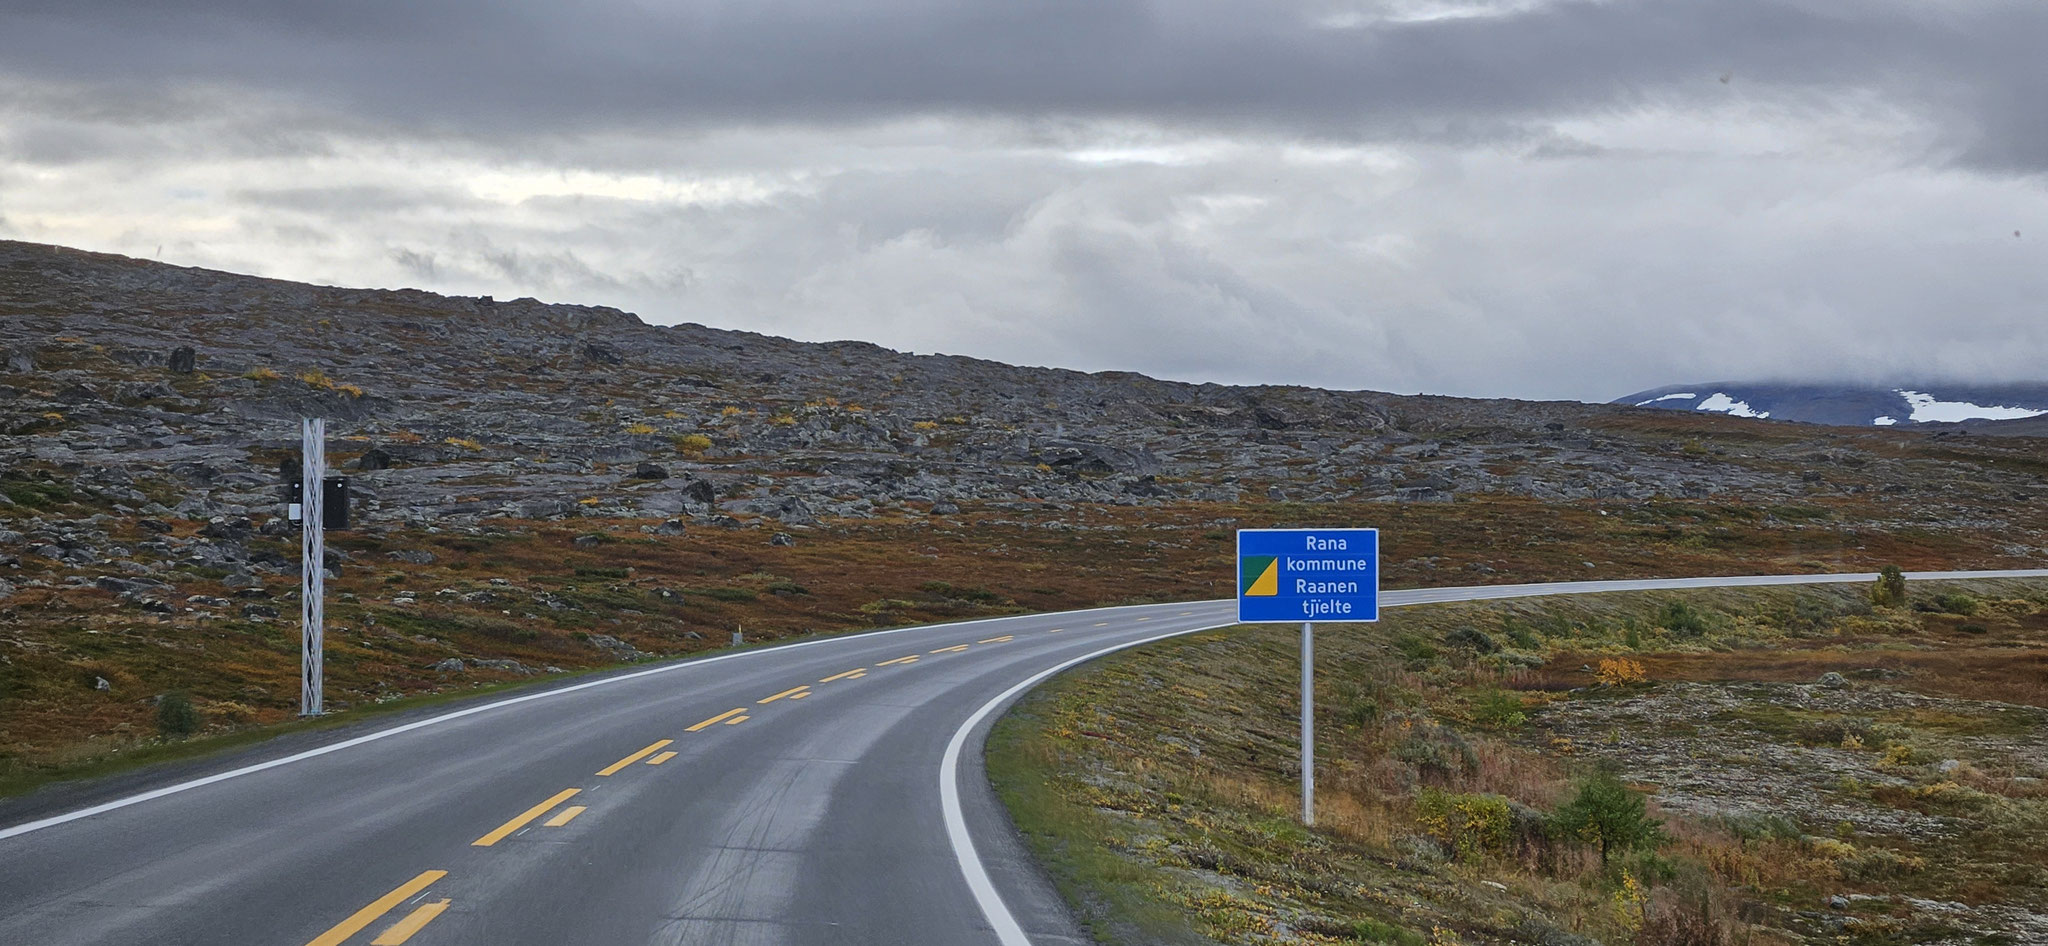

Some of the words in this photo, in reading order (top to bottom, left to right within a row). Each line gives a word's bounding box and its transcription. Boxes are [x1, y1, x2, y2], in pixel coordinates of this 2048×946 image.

[1306, 535, 1347, 551] Rana
[1287, 556, 1367, 571] kommune
[1296, 579, 1358, 594] Raanen
